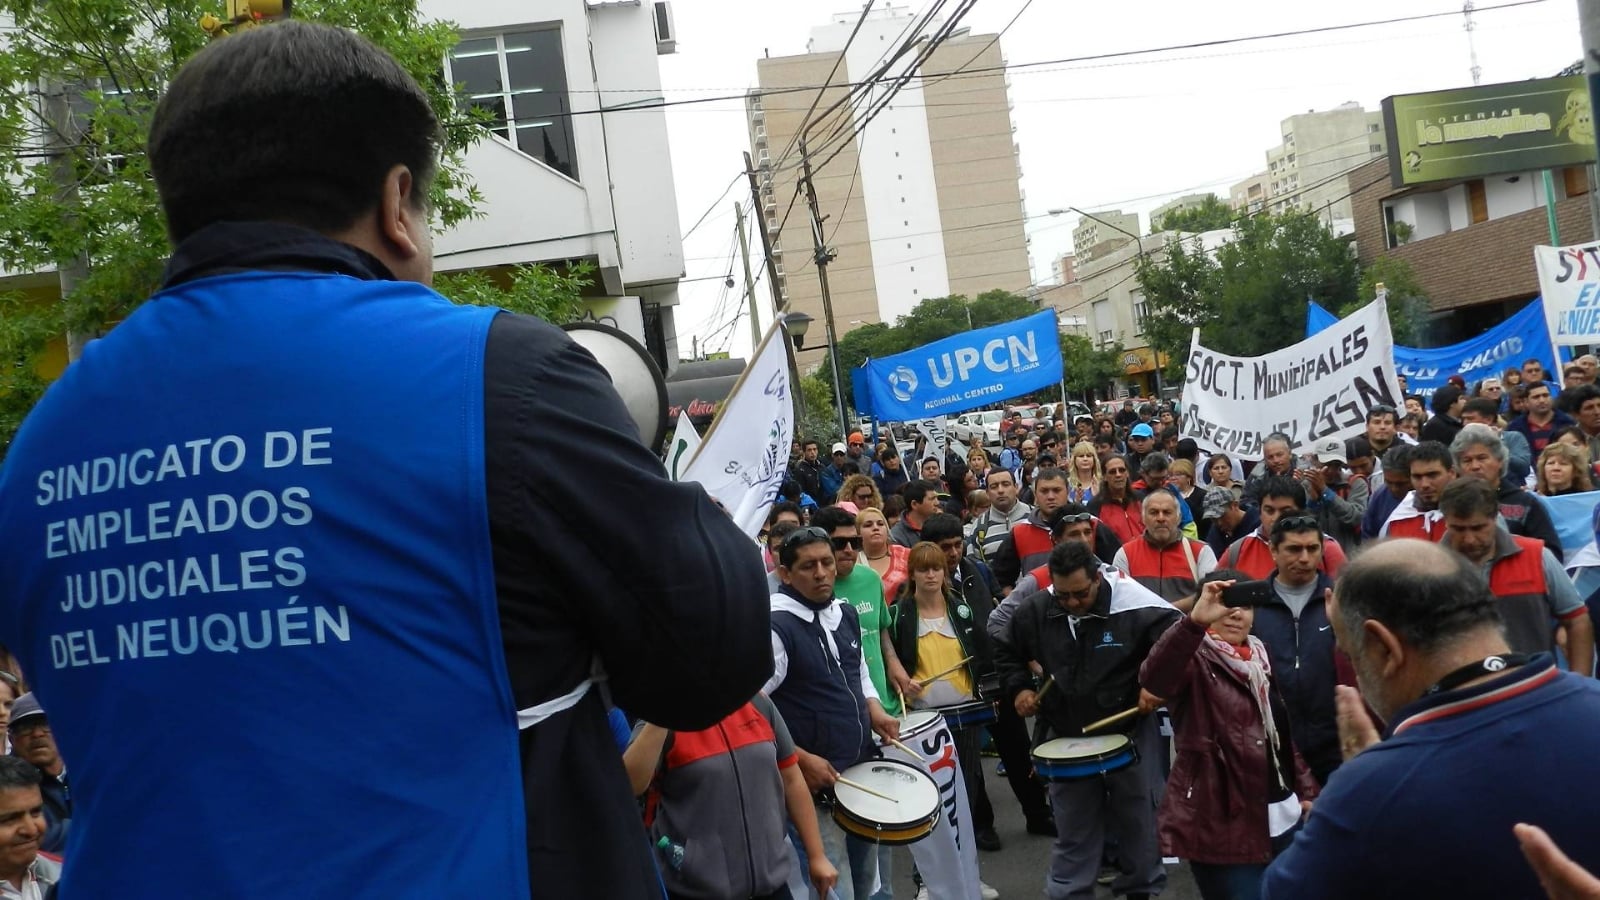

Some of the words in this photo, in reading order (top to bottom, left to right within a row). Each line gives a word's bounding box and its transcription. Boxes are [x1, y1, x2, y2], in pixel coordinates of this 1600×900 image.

[928, 330, 1039, 388] UPCN
[1458, 336, 1523, 374] SALUD
[924, 394, 963, 409] REGIONAL
[965, 383, 1004, 399] CENTRO
[36, 435, 246, 506] SINDICATO
[264, 427, 332, 468] DE
[46, 486, 313, 559] EMPLEADOS
[61, 547, 307, 612] JUDICIALES
[50, 629, 111, 669] DEL
[118, 595, 350, 660] NEUQUÉN
